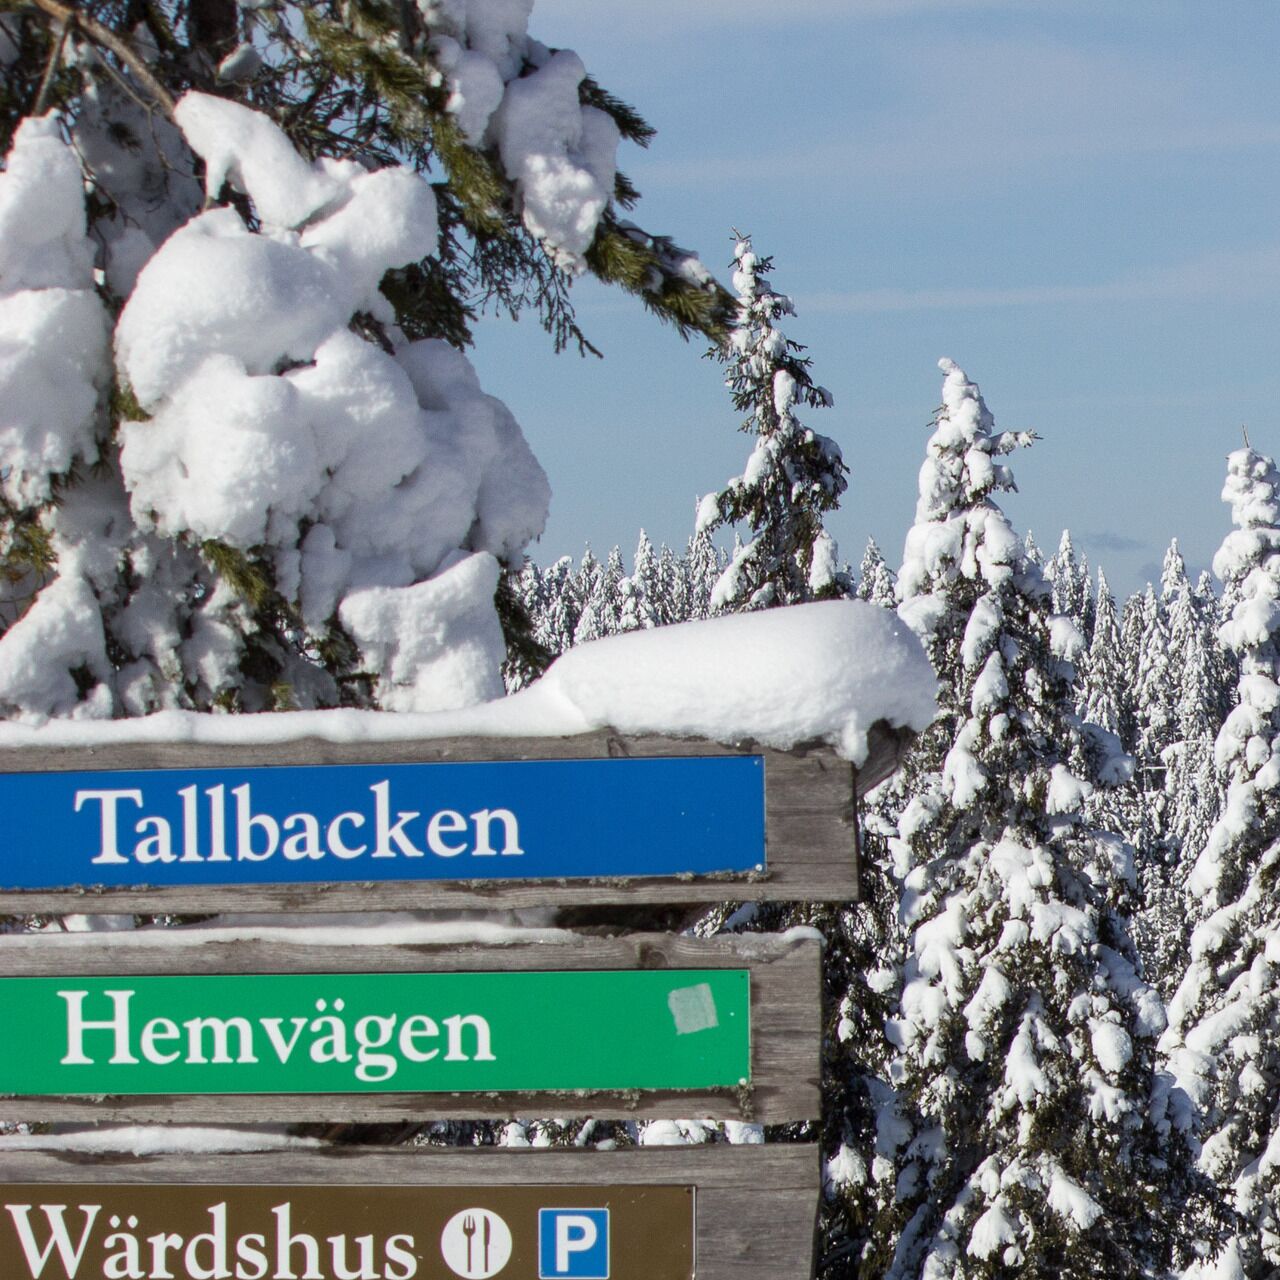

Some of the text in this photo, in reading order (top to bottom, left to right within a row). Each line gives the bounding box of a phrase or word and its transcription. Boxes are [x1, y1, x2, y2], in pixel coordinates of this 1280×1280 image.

[74, 780, 524, 864] Tallbacken
[57, 990, 496, 1082] Hemvägen
[5, 1203, 596, 1280] Wärdshus P
